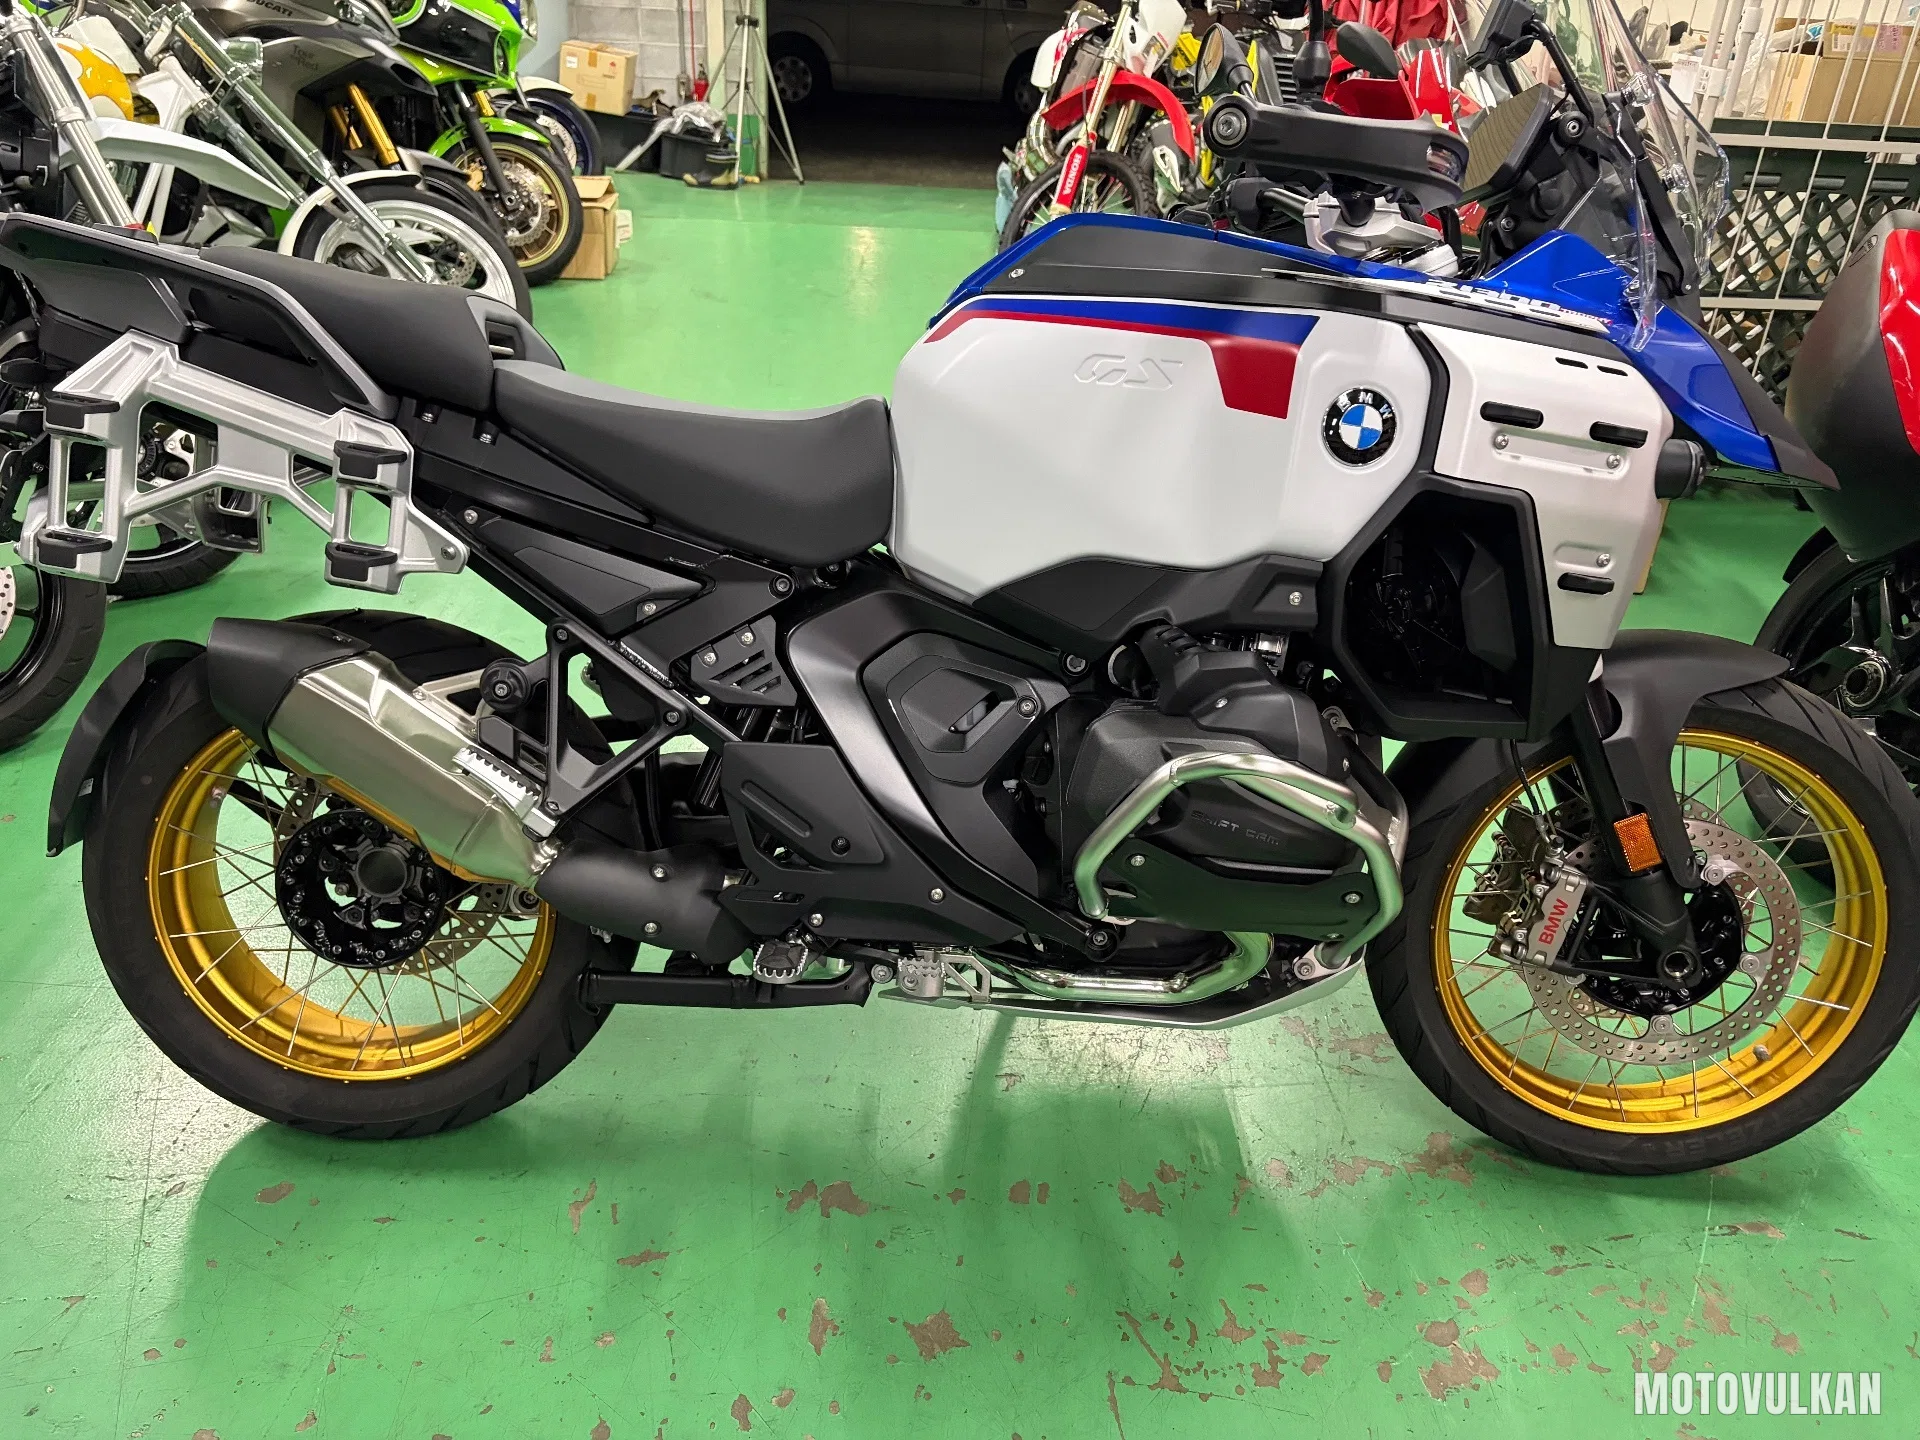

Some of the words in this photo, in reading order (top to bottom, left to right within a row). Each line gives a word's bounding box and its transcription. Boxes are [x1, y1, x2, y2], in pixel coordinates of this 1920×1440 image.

[246, 0, 293, 16] UCATI
[1063, 153, 1083, 195] HONDA
[1073, 353, 1184, 391] GS
[1538, 897, 1569, 945] BMW
